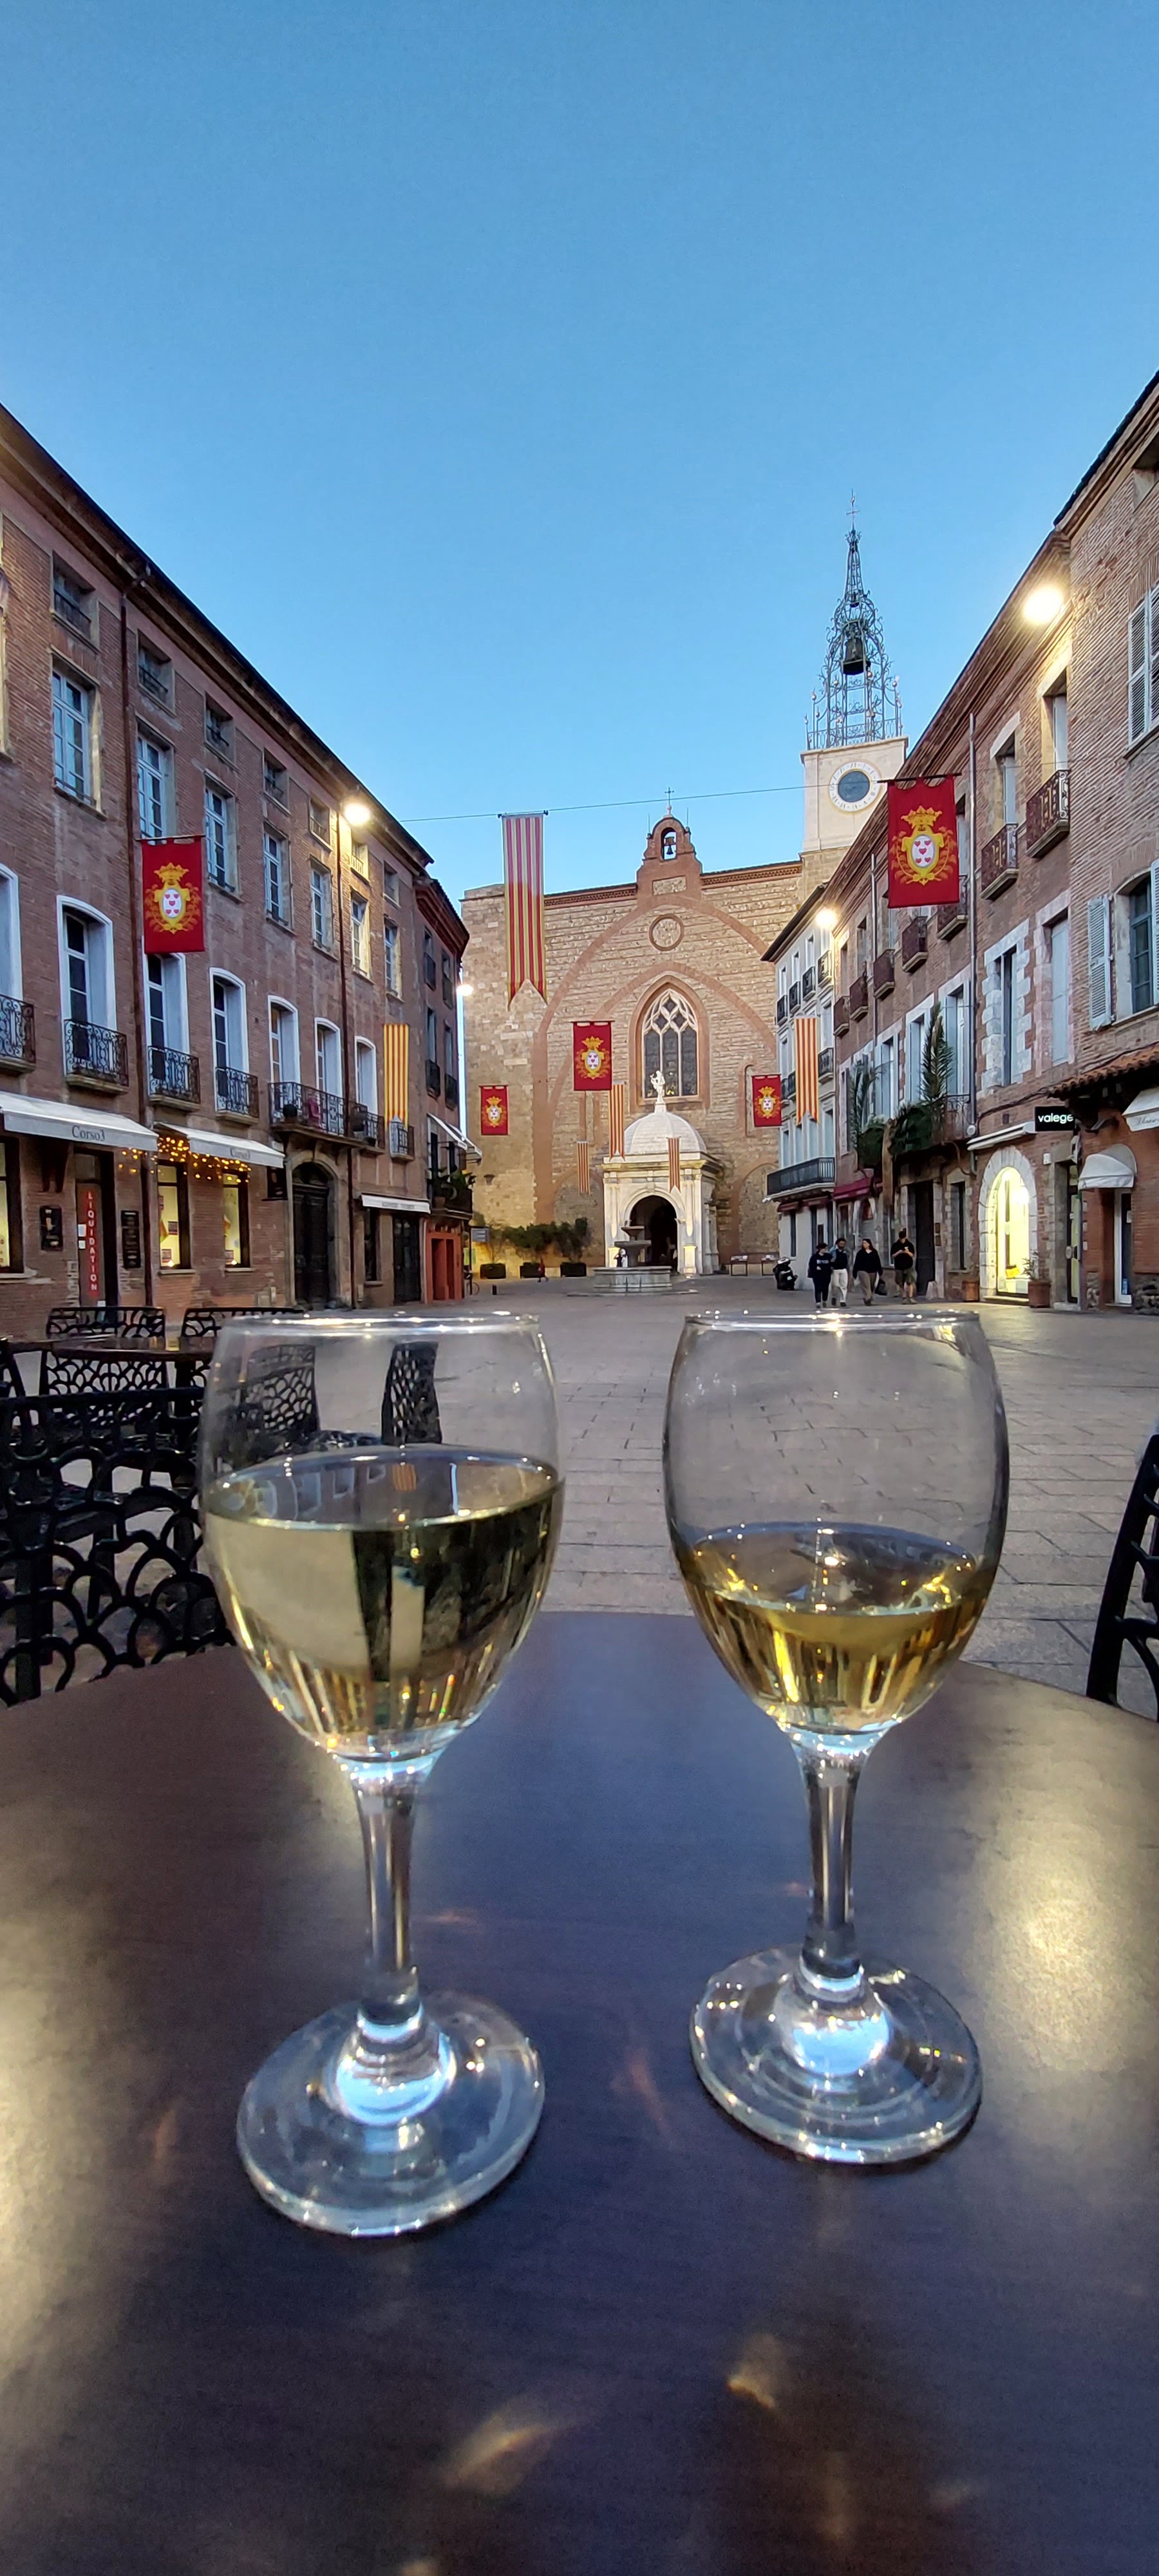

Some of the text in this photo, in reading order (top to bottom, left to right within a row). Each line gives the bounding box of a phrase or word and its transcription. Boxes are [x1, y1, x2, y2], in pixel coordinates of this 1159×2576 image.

[1038, 1113, 1074, 1124] valege
[71, 1124, 105, 1141] Corso3
[87, 1191, 97, 1291] LIQUIDATION
